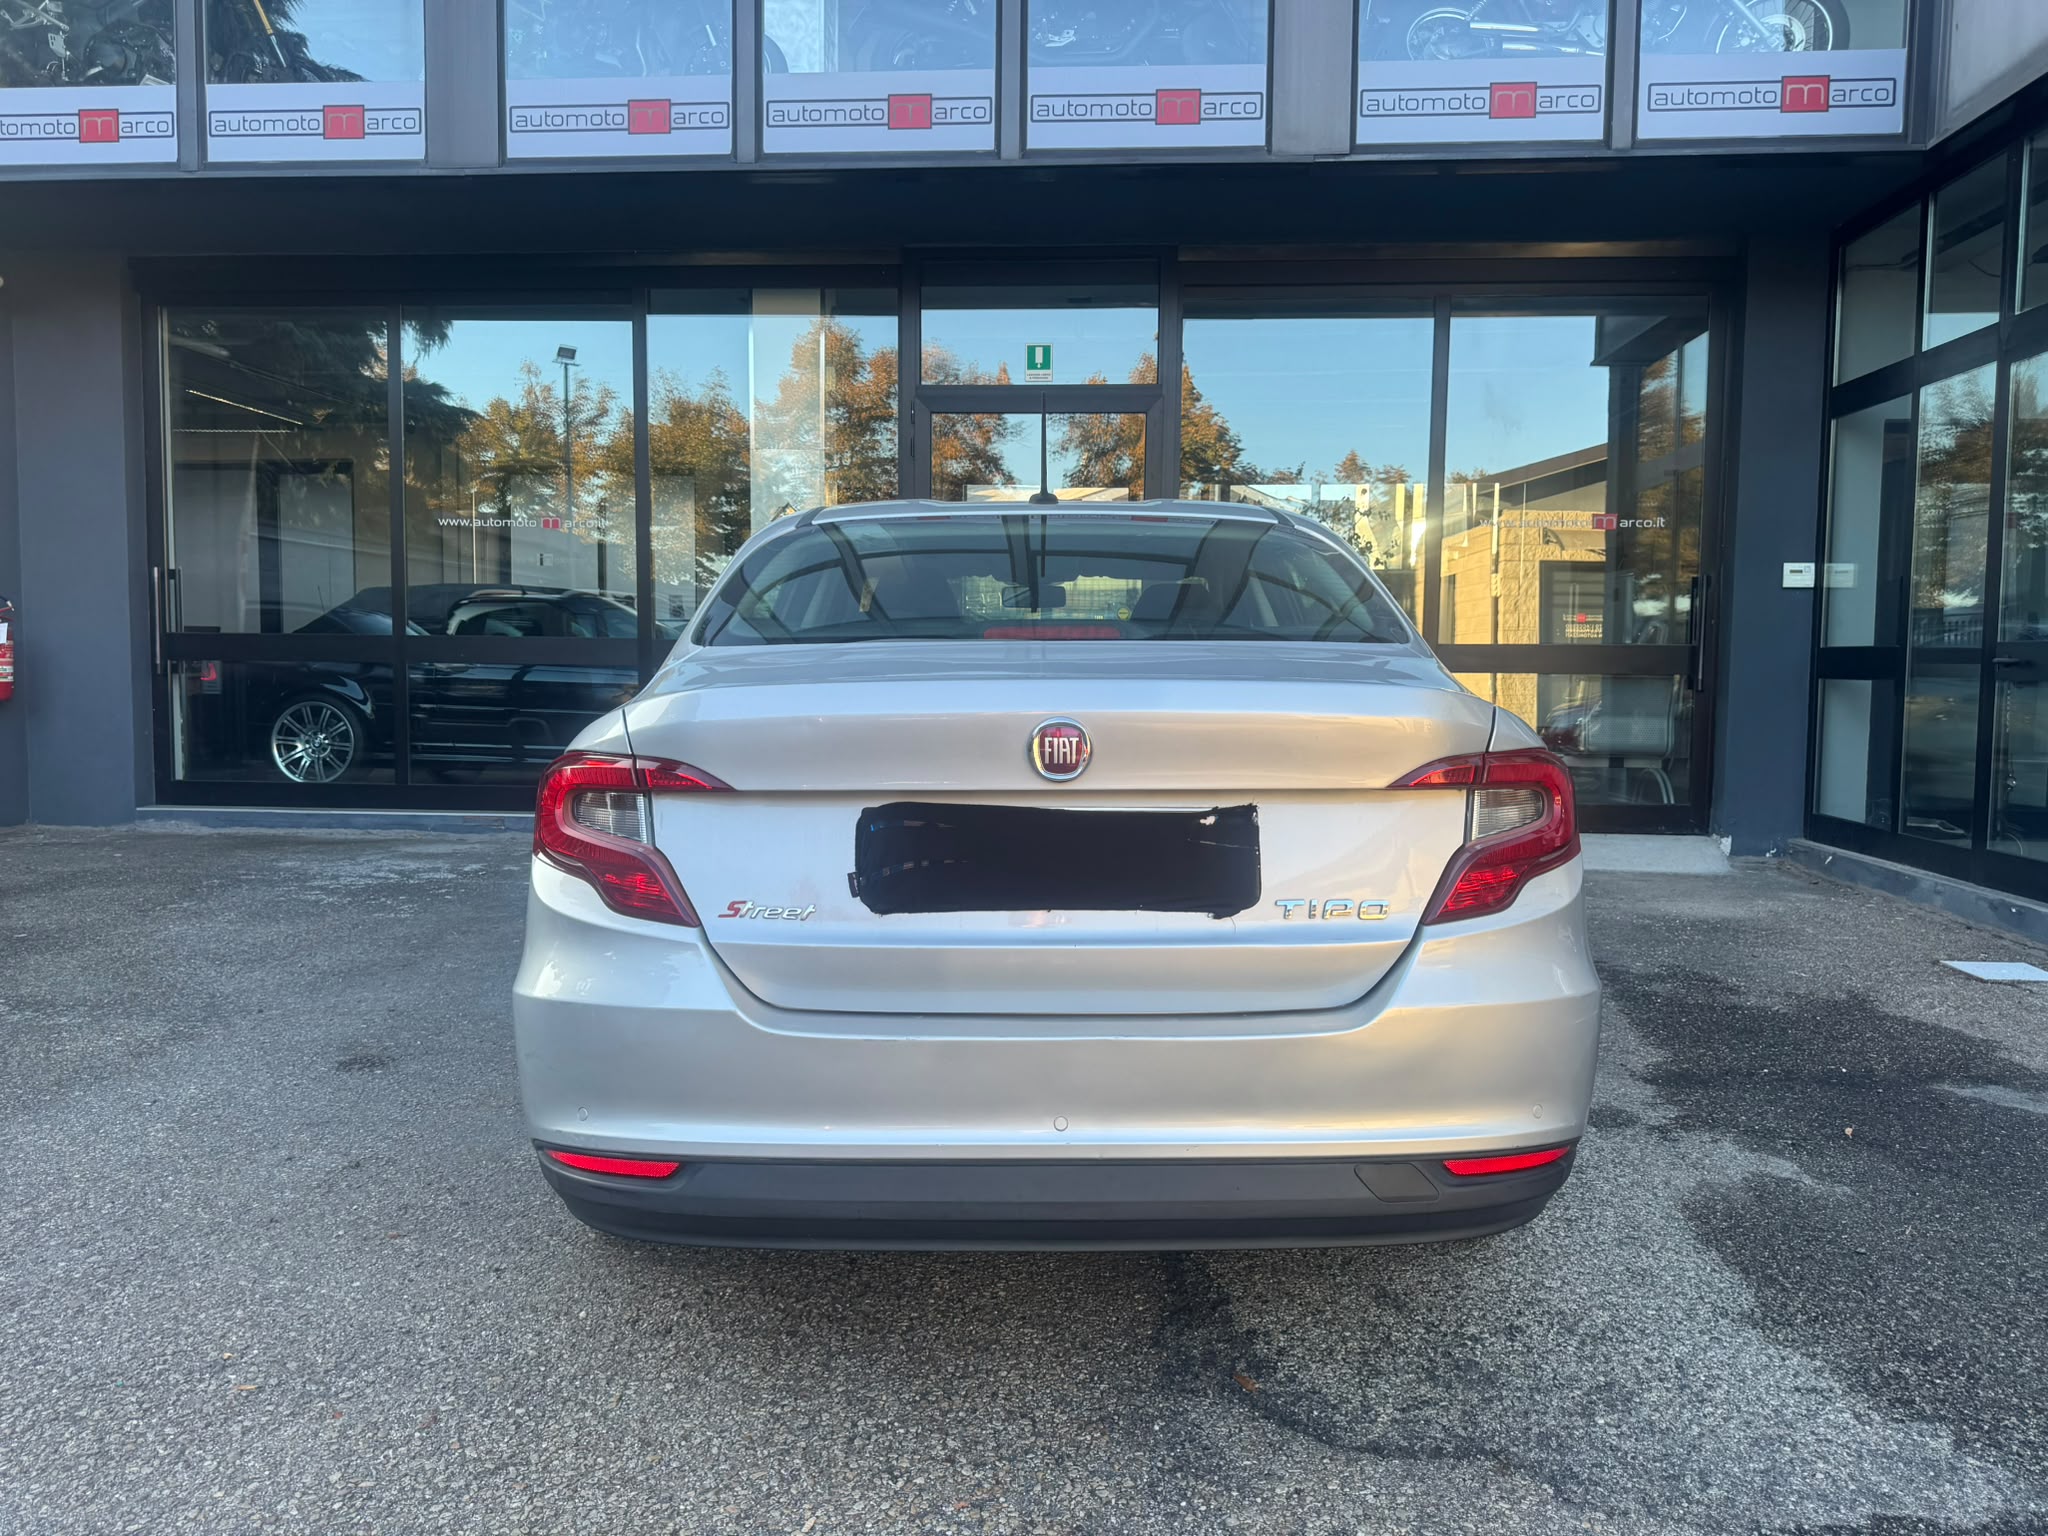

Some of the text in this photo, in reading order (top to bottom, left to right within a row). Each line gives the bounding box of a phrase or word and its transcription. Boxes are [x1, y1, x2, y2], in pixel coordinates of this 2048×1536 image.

[1366, 92, 1486, 112] automoto
[1654, 86, 1778, 106] automoto
[772, 103, 885, 122] automoto
[1036, 98, 1152, 117] automoto
[214, 114, 320, 132] automoto
[515, 109, 625, 128] automoto
[1044, 737, 1080, 764] FIAT
[718, 900, 816, 921] Street
[1275, 899, 1390, 920] TIPO
